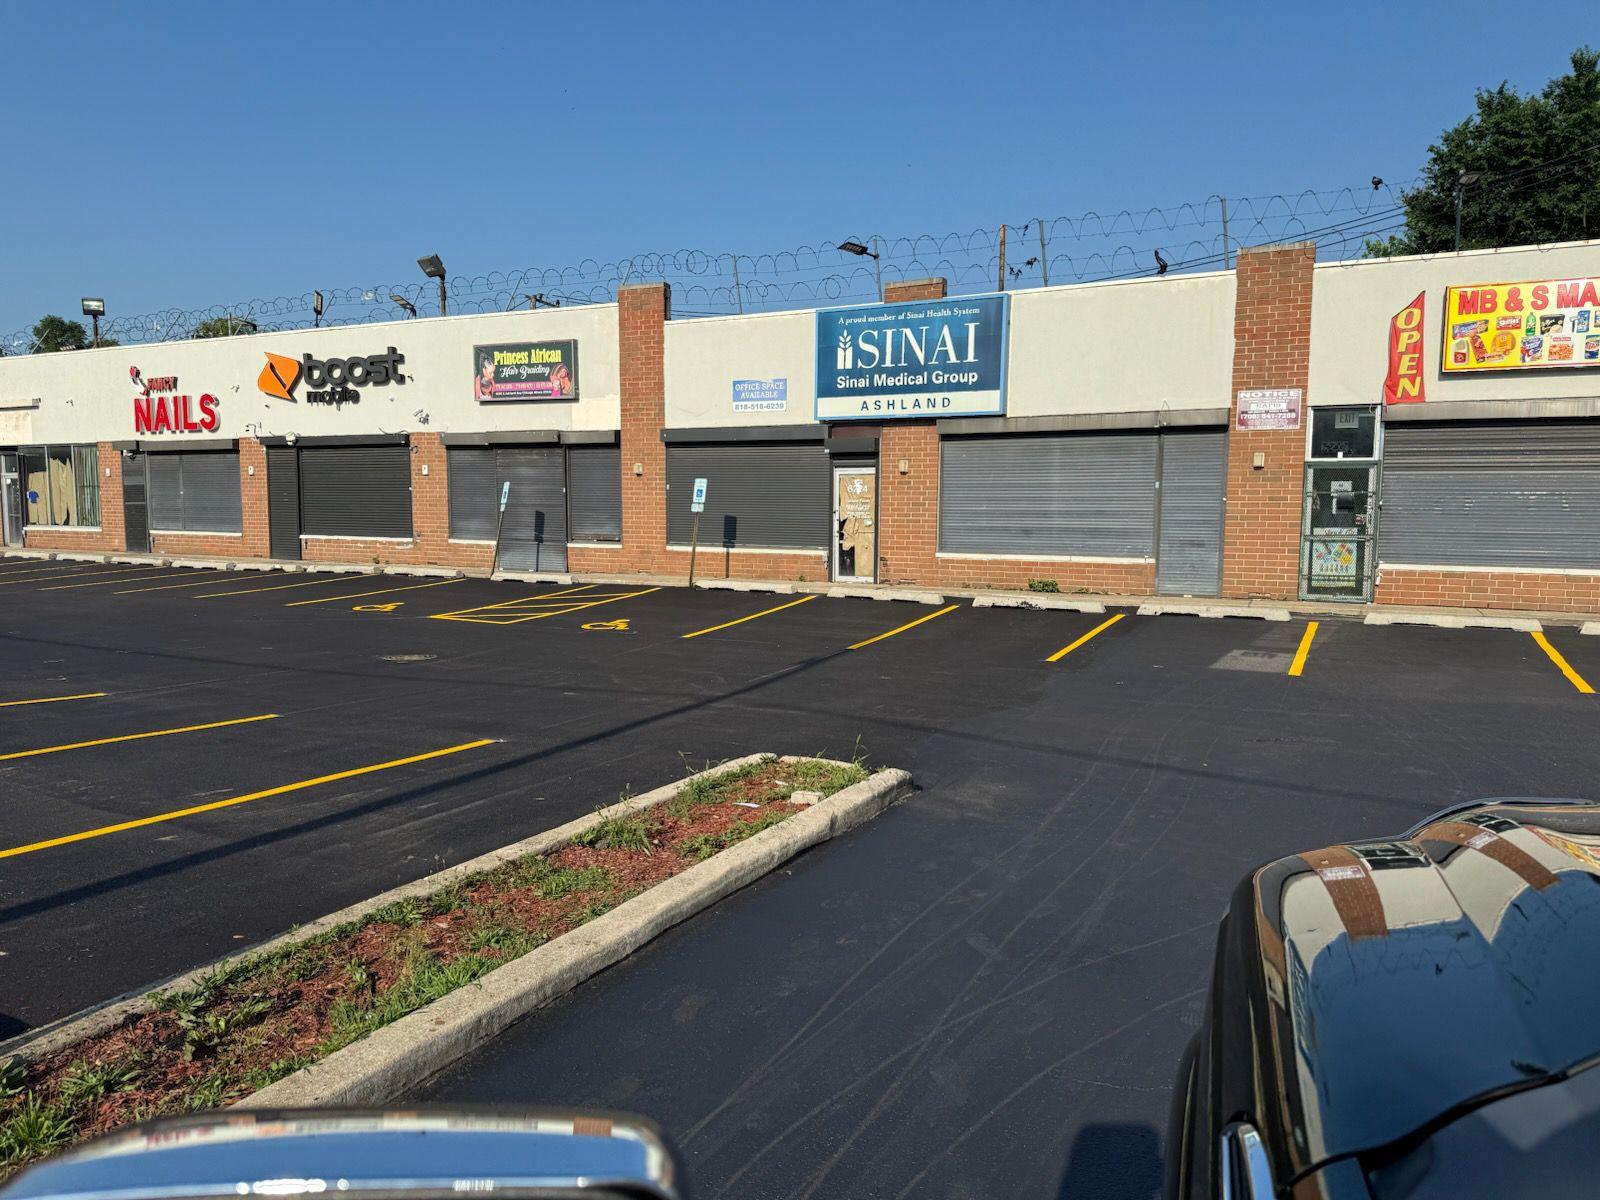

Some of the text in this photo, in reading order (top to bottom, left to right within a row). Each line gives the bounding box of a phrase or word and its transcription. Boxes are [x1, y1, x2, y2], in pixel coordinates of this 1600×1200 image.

[1458, 289, 1497, 315] MB
[1505, 287, 1524, 312] &
[1531, 285, 1549, 311] S
[846, 316, 867, 325] proud
[907, 312, 925, 320] Sinai
[927, 309, 952, 317] Health
[953, 307, 980, 316] System
[857, 322, 980, 369] SINAI
[1396, 307, 1421, 399] OPEN
[493, 348, 561, 365] Princess African
[303, 346, 405, 389] boost
[500, 365, 550, 379] Hair Braiding
[735, 381, 784, 391] OFFICE SPACE
[837, 370, 978, 389] Sinai Medical Group
[307, 387, 361, 406] mobile
[740, 391, 778, 399] AVAILABLE
[861, 397, 951, 411] ASHLAND
[134, 394, 218, 434] NAILS
[1340, 411, 1355, 423] EXIT
